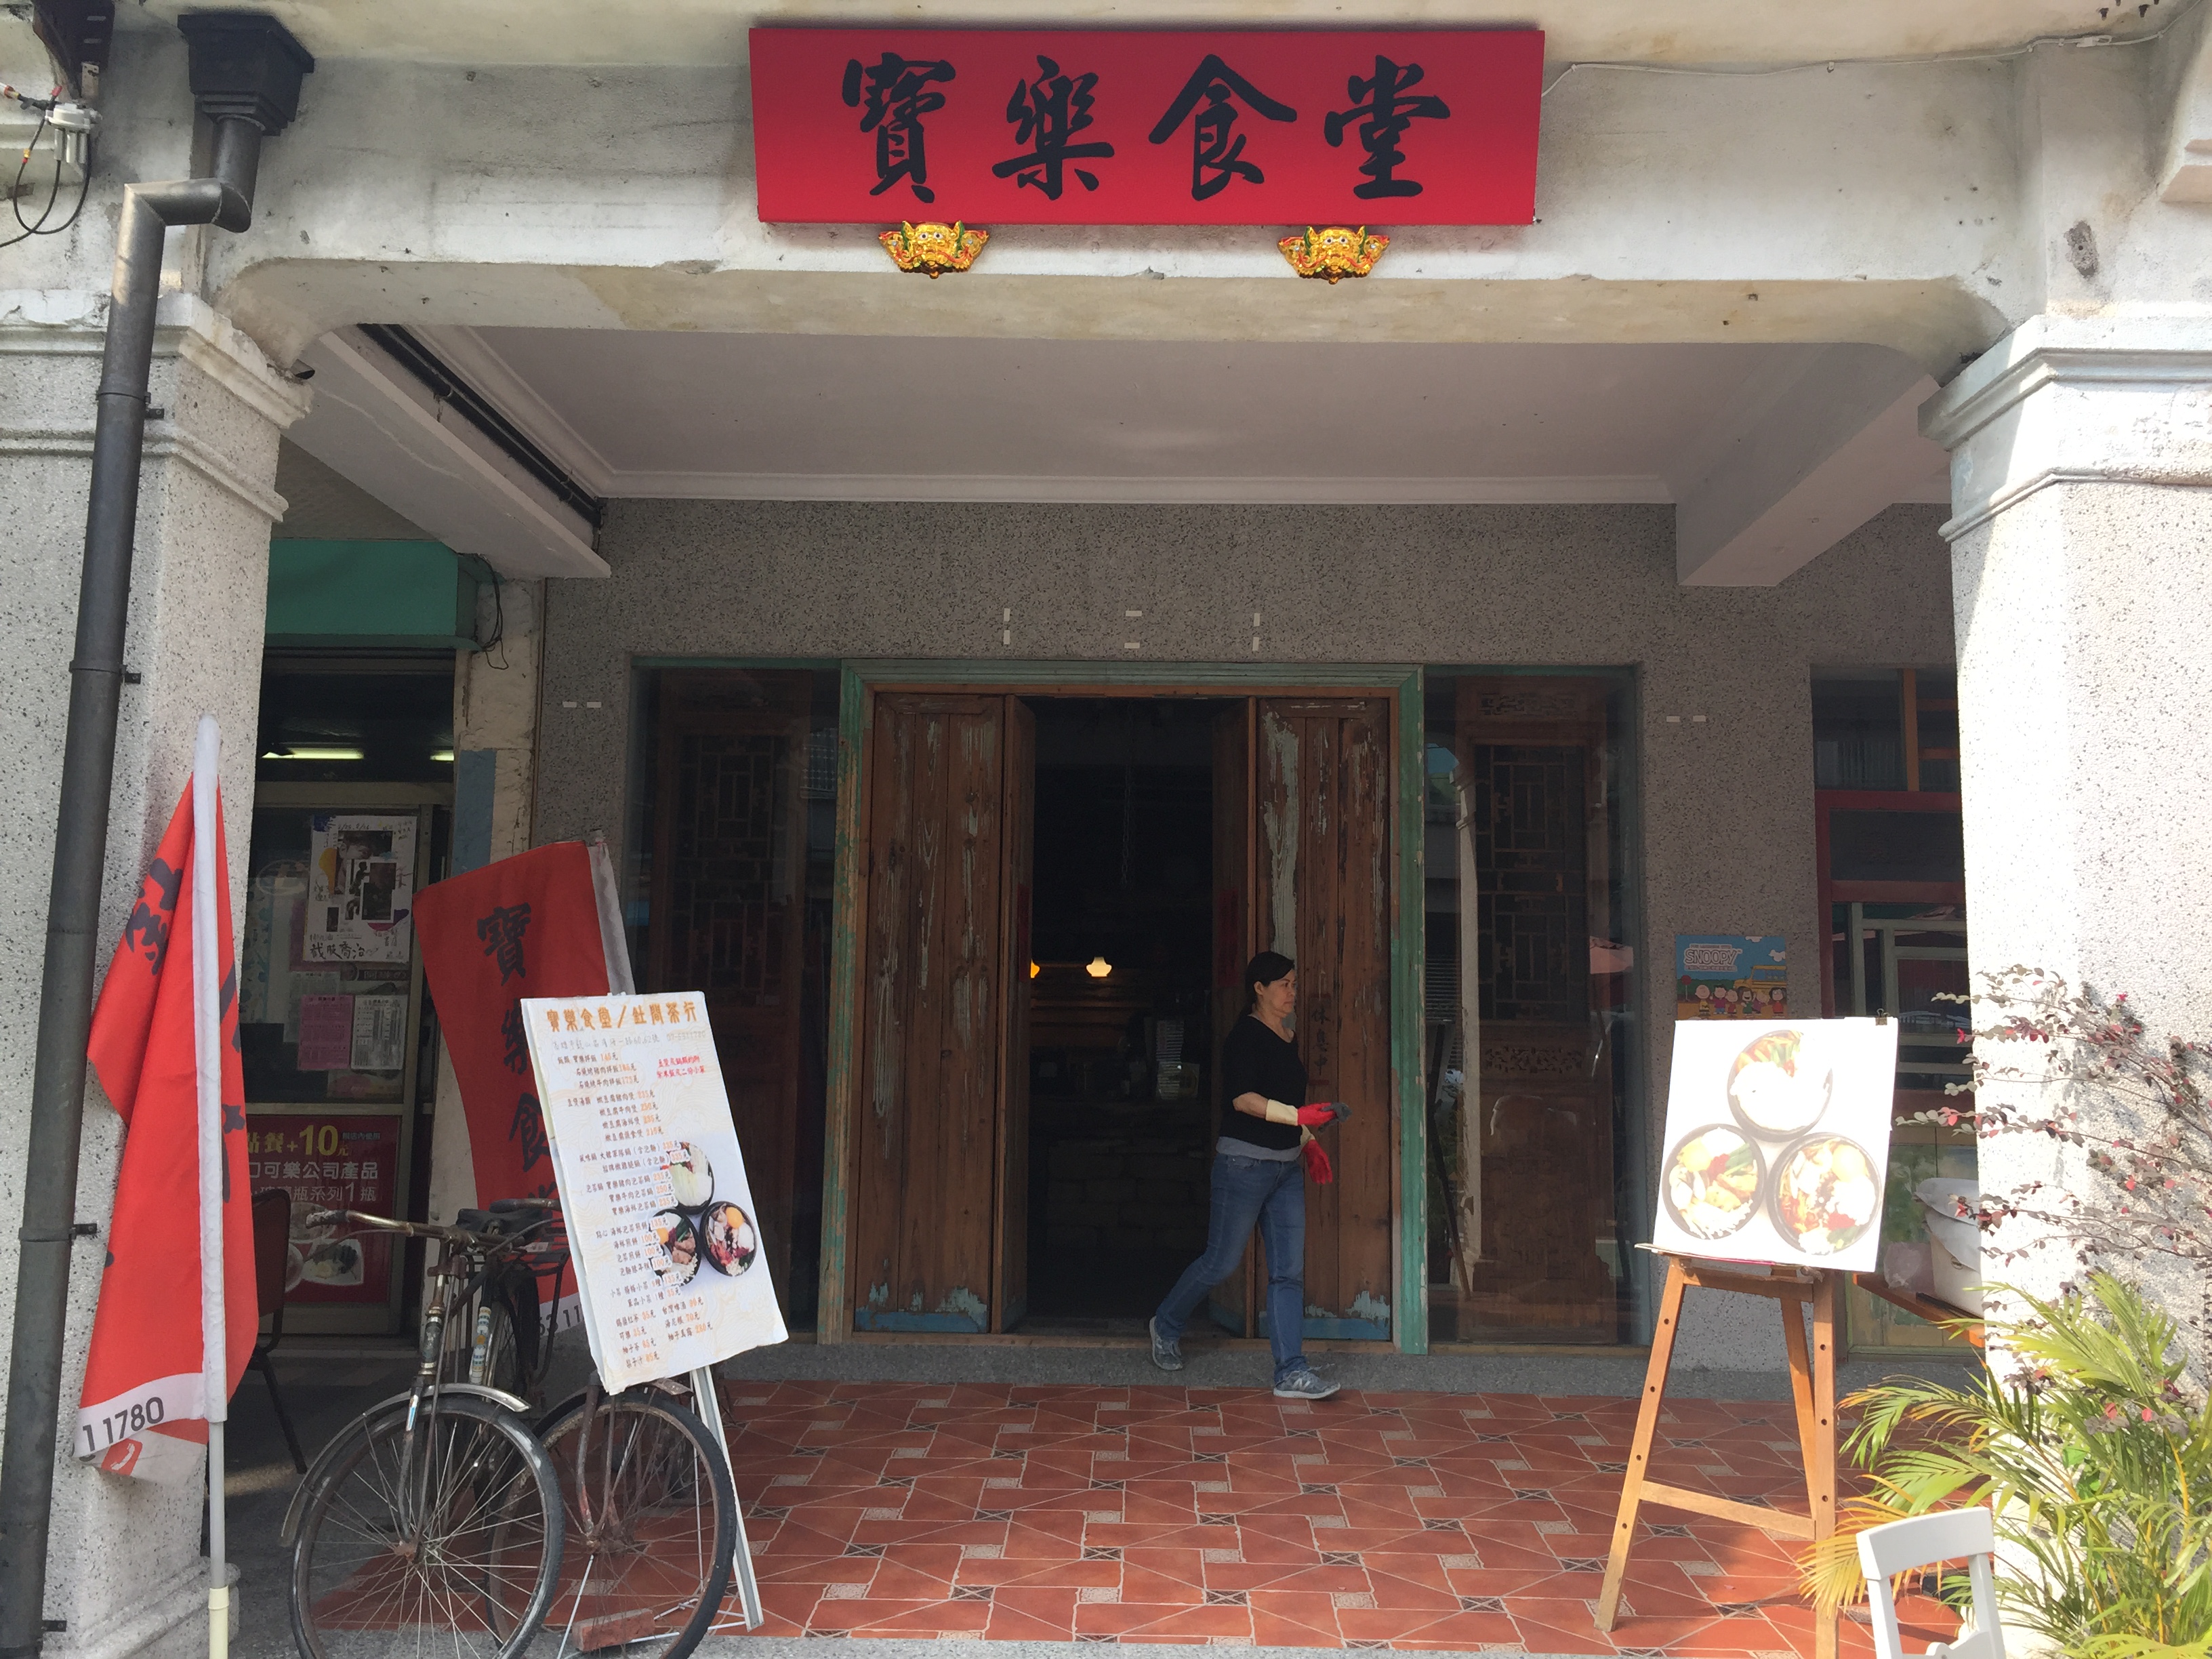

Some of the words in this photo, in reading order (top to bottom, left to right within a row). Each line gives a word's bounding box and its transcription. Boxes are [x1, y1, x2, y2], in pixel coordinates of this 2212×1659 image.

[840, 52, 1450, 204] 寶樂食堂
[1685, 949, 1738, 965] SNOOPY
[477, 903, 556, 1200] 寶樂食
[1311, 1004, 1331, 1076] 休息中
[641, 1232, 659, 1242] 100元
[644, 1246, 662, 1256] 100元
[653, 1256, 671, 1268] 100元
[68, 1396, 165, 1457] 11780
